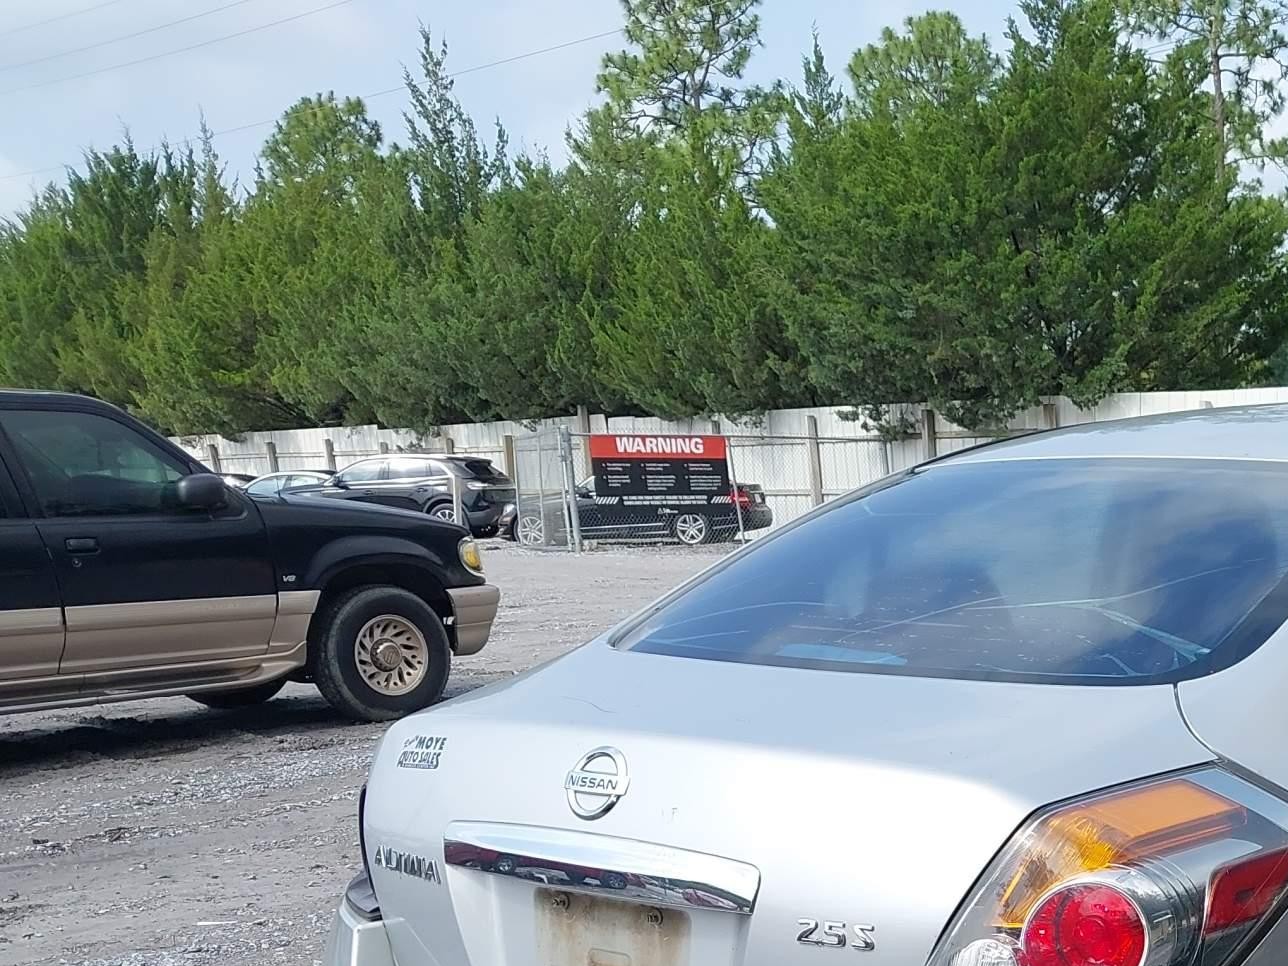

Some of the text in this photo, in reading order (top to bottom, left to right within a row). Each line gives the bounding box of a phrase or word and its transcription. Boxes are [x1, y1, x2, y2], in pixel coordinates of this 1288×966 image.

[615, 436, 704, 454] WARNING
[397, 750, 441, 769] AUTO SALES
[568, 775, 618, 790] NISSAN
[850, 923, 875, 951] S
